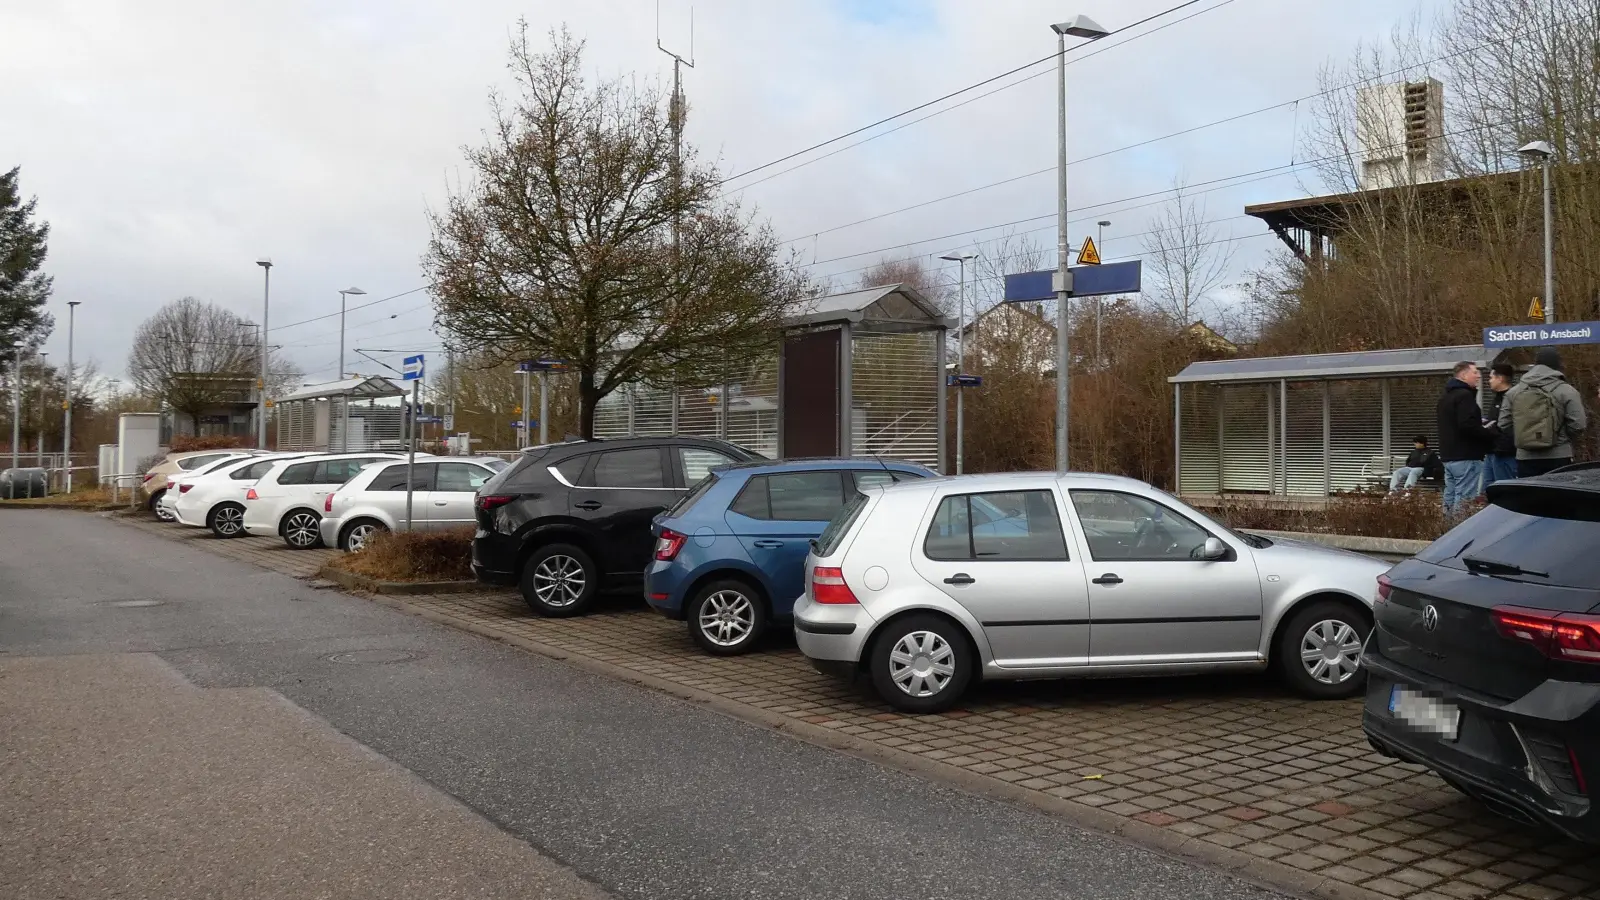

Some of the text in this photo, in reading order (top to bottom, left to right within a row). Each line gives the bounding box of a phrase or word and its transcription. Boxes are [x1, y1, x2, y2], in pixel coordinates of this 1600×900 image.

[1488, 327, 1591, 342] Sachsen (b Ansbach)
